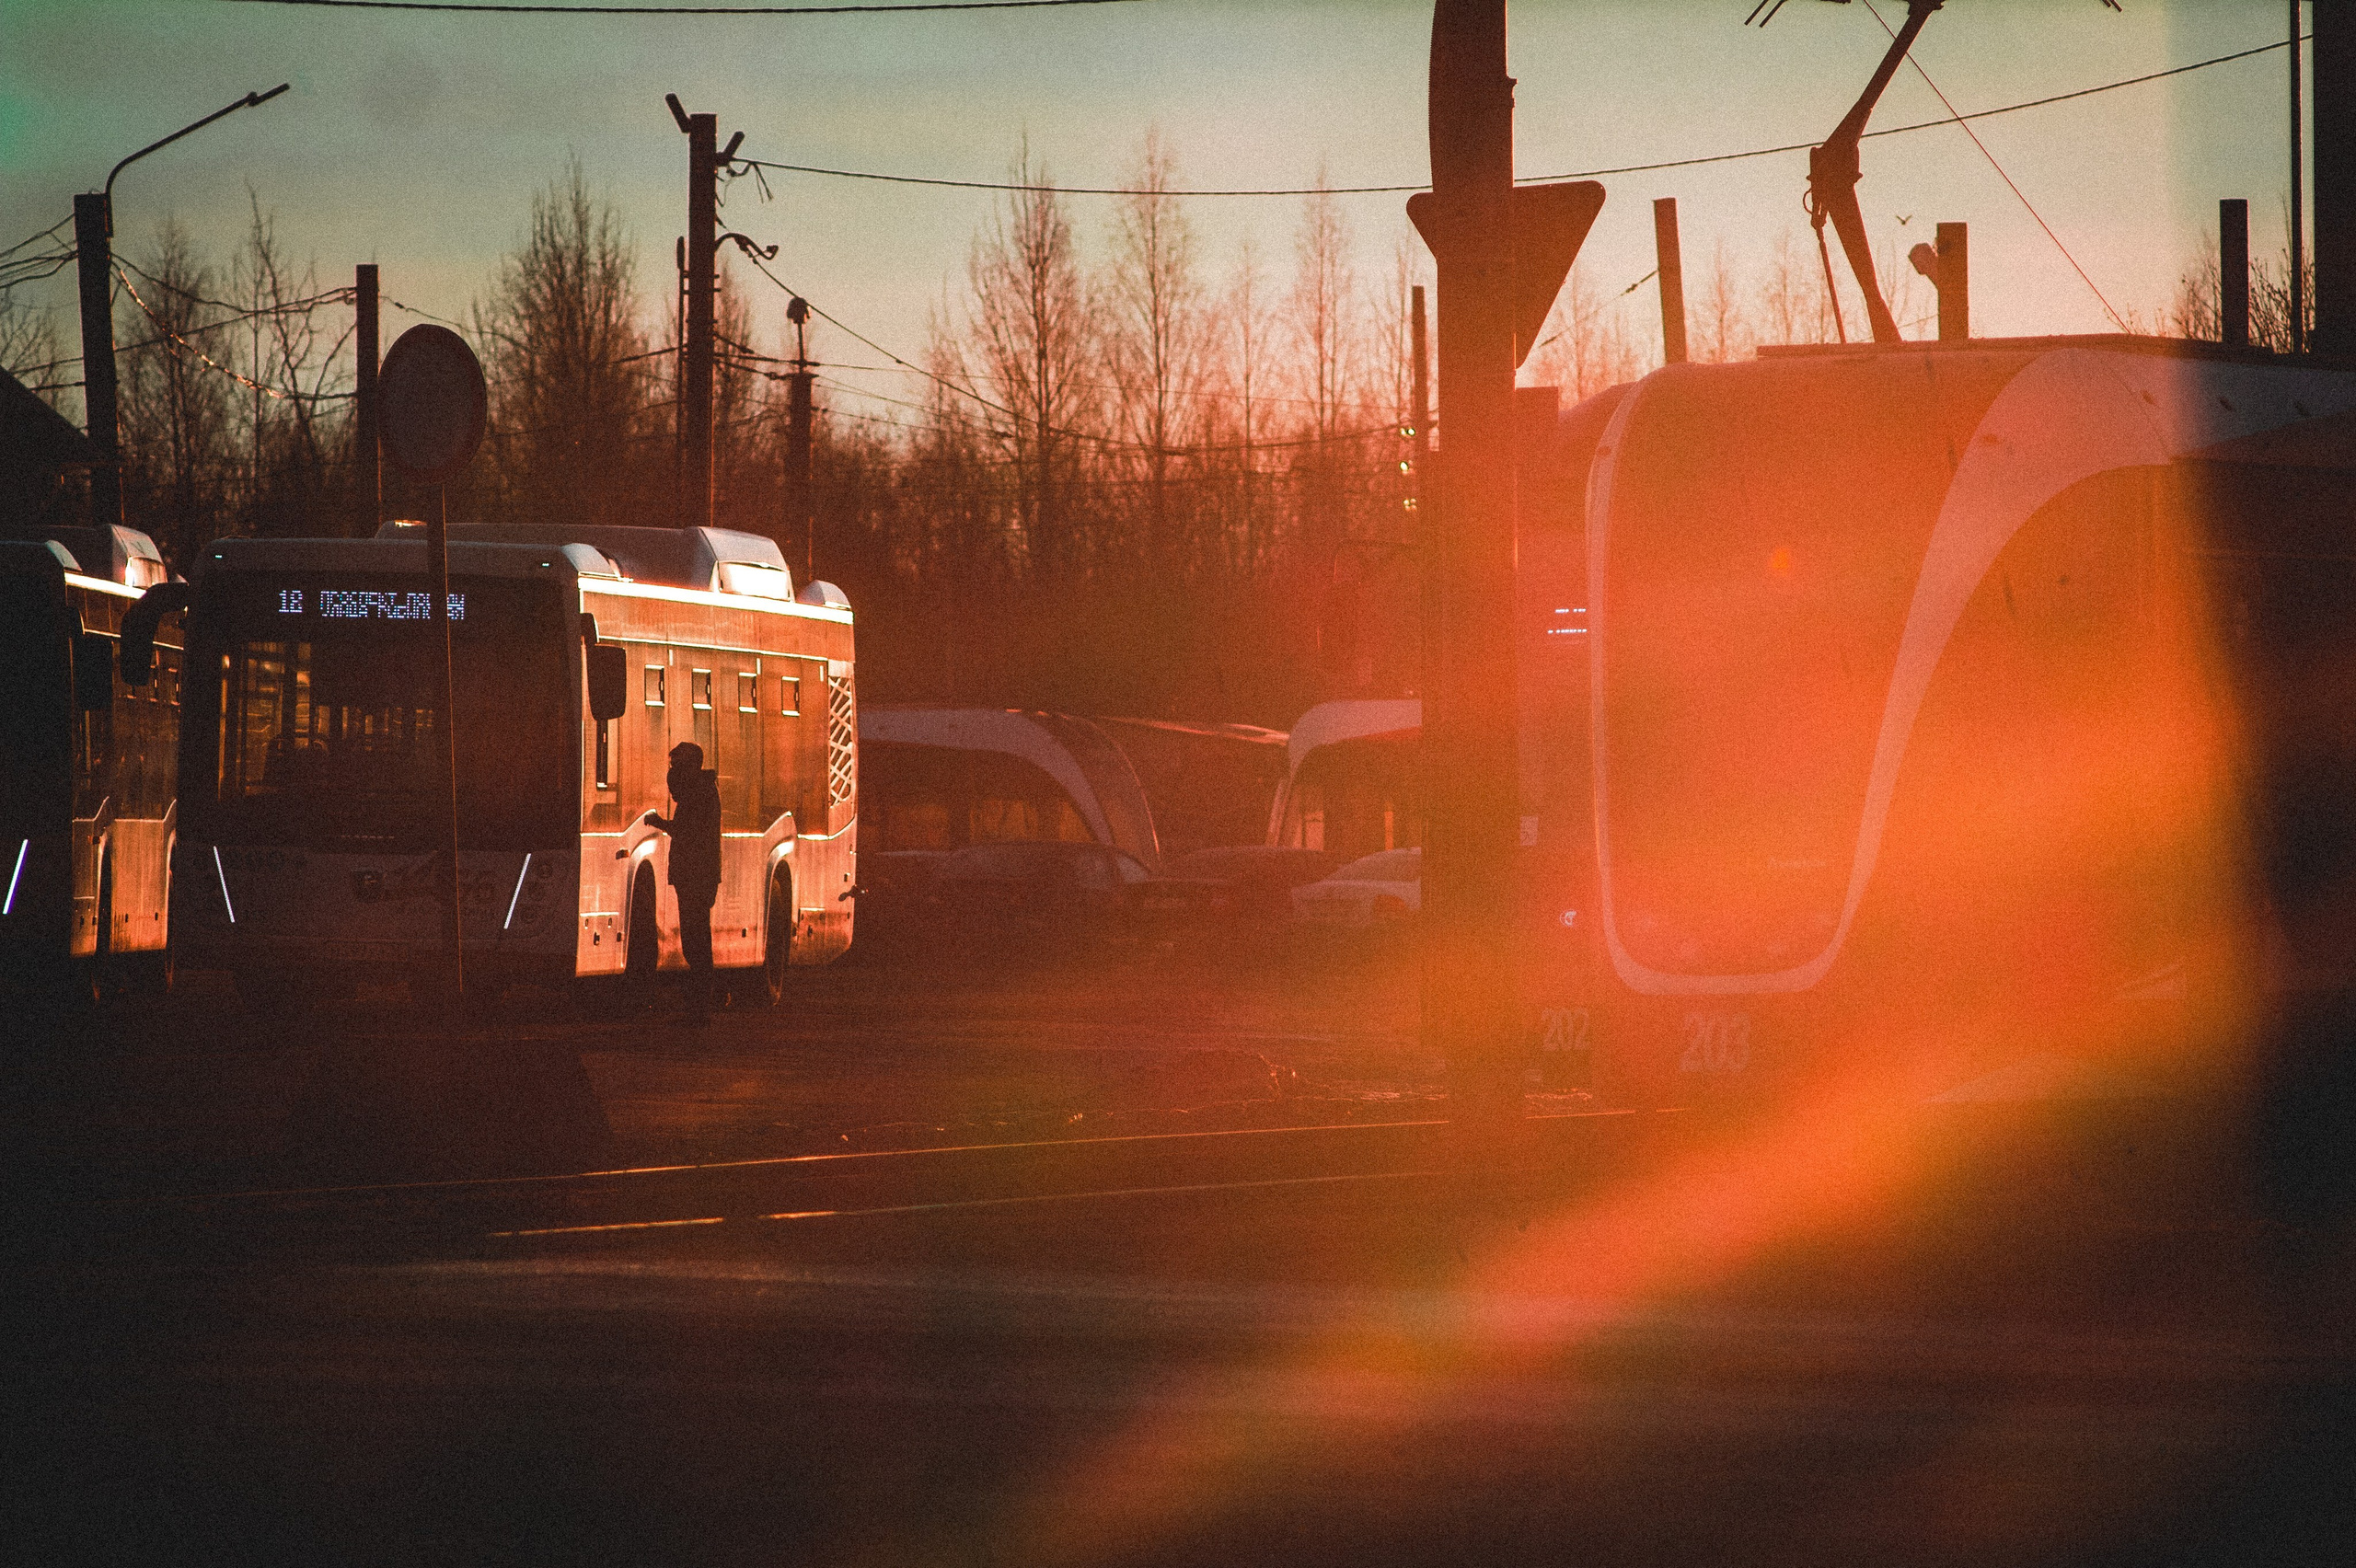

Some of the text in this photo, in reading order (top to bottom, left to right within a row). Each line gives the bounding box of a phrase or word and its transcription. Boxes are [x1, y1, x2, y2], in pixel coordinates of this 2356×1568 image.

[278, 590, 303, 613] 18
[1541, 1007, 1590, 1052] 202
[1680, 1011, 1751, 1073] 203
